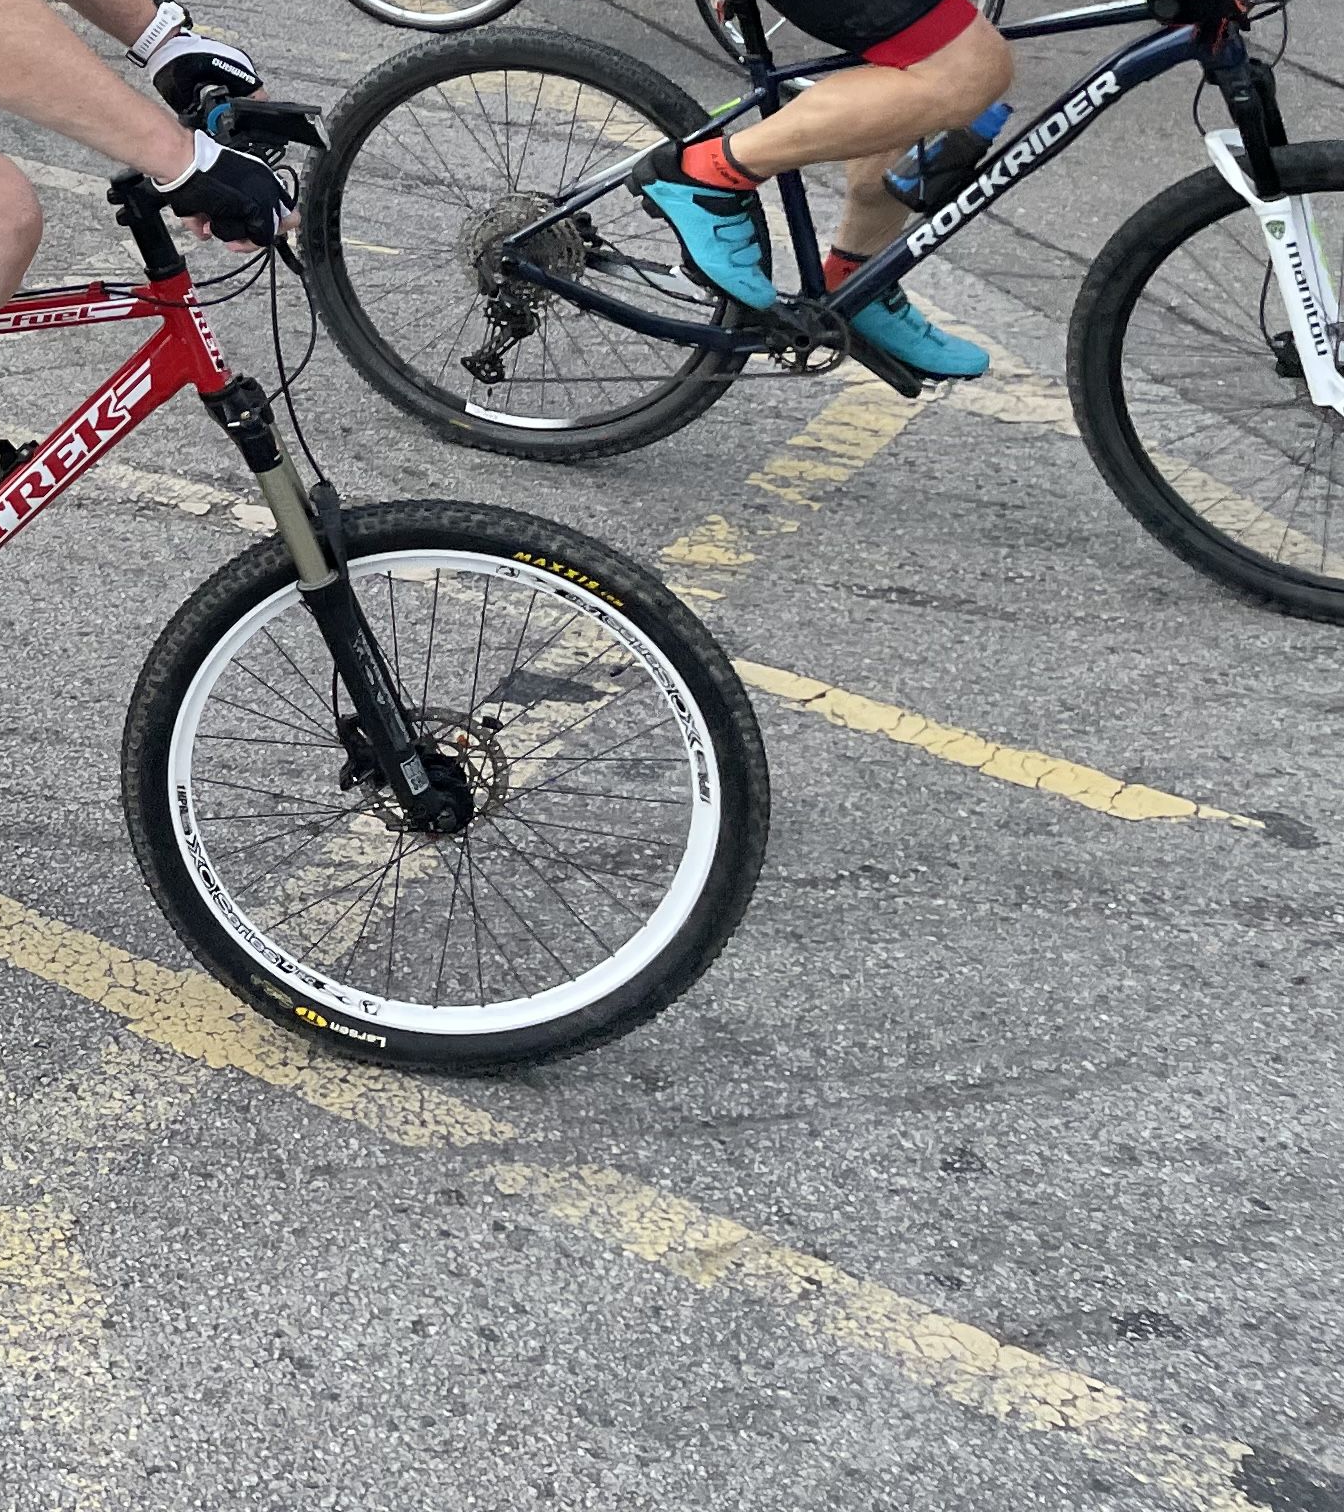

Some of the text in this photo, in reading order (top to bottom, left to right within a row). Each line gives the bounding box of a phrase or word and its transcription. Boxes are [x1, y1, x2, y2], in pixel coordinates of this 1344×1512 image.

[906, 70, 1121, 258] ROCKRIDER
[1286, 241, 1329, 356] manitou
[513, 551, 600, 589] MAXXIS
[329, 1021, 387, 1049] Larsen
